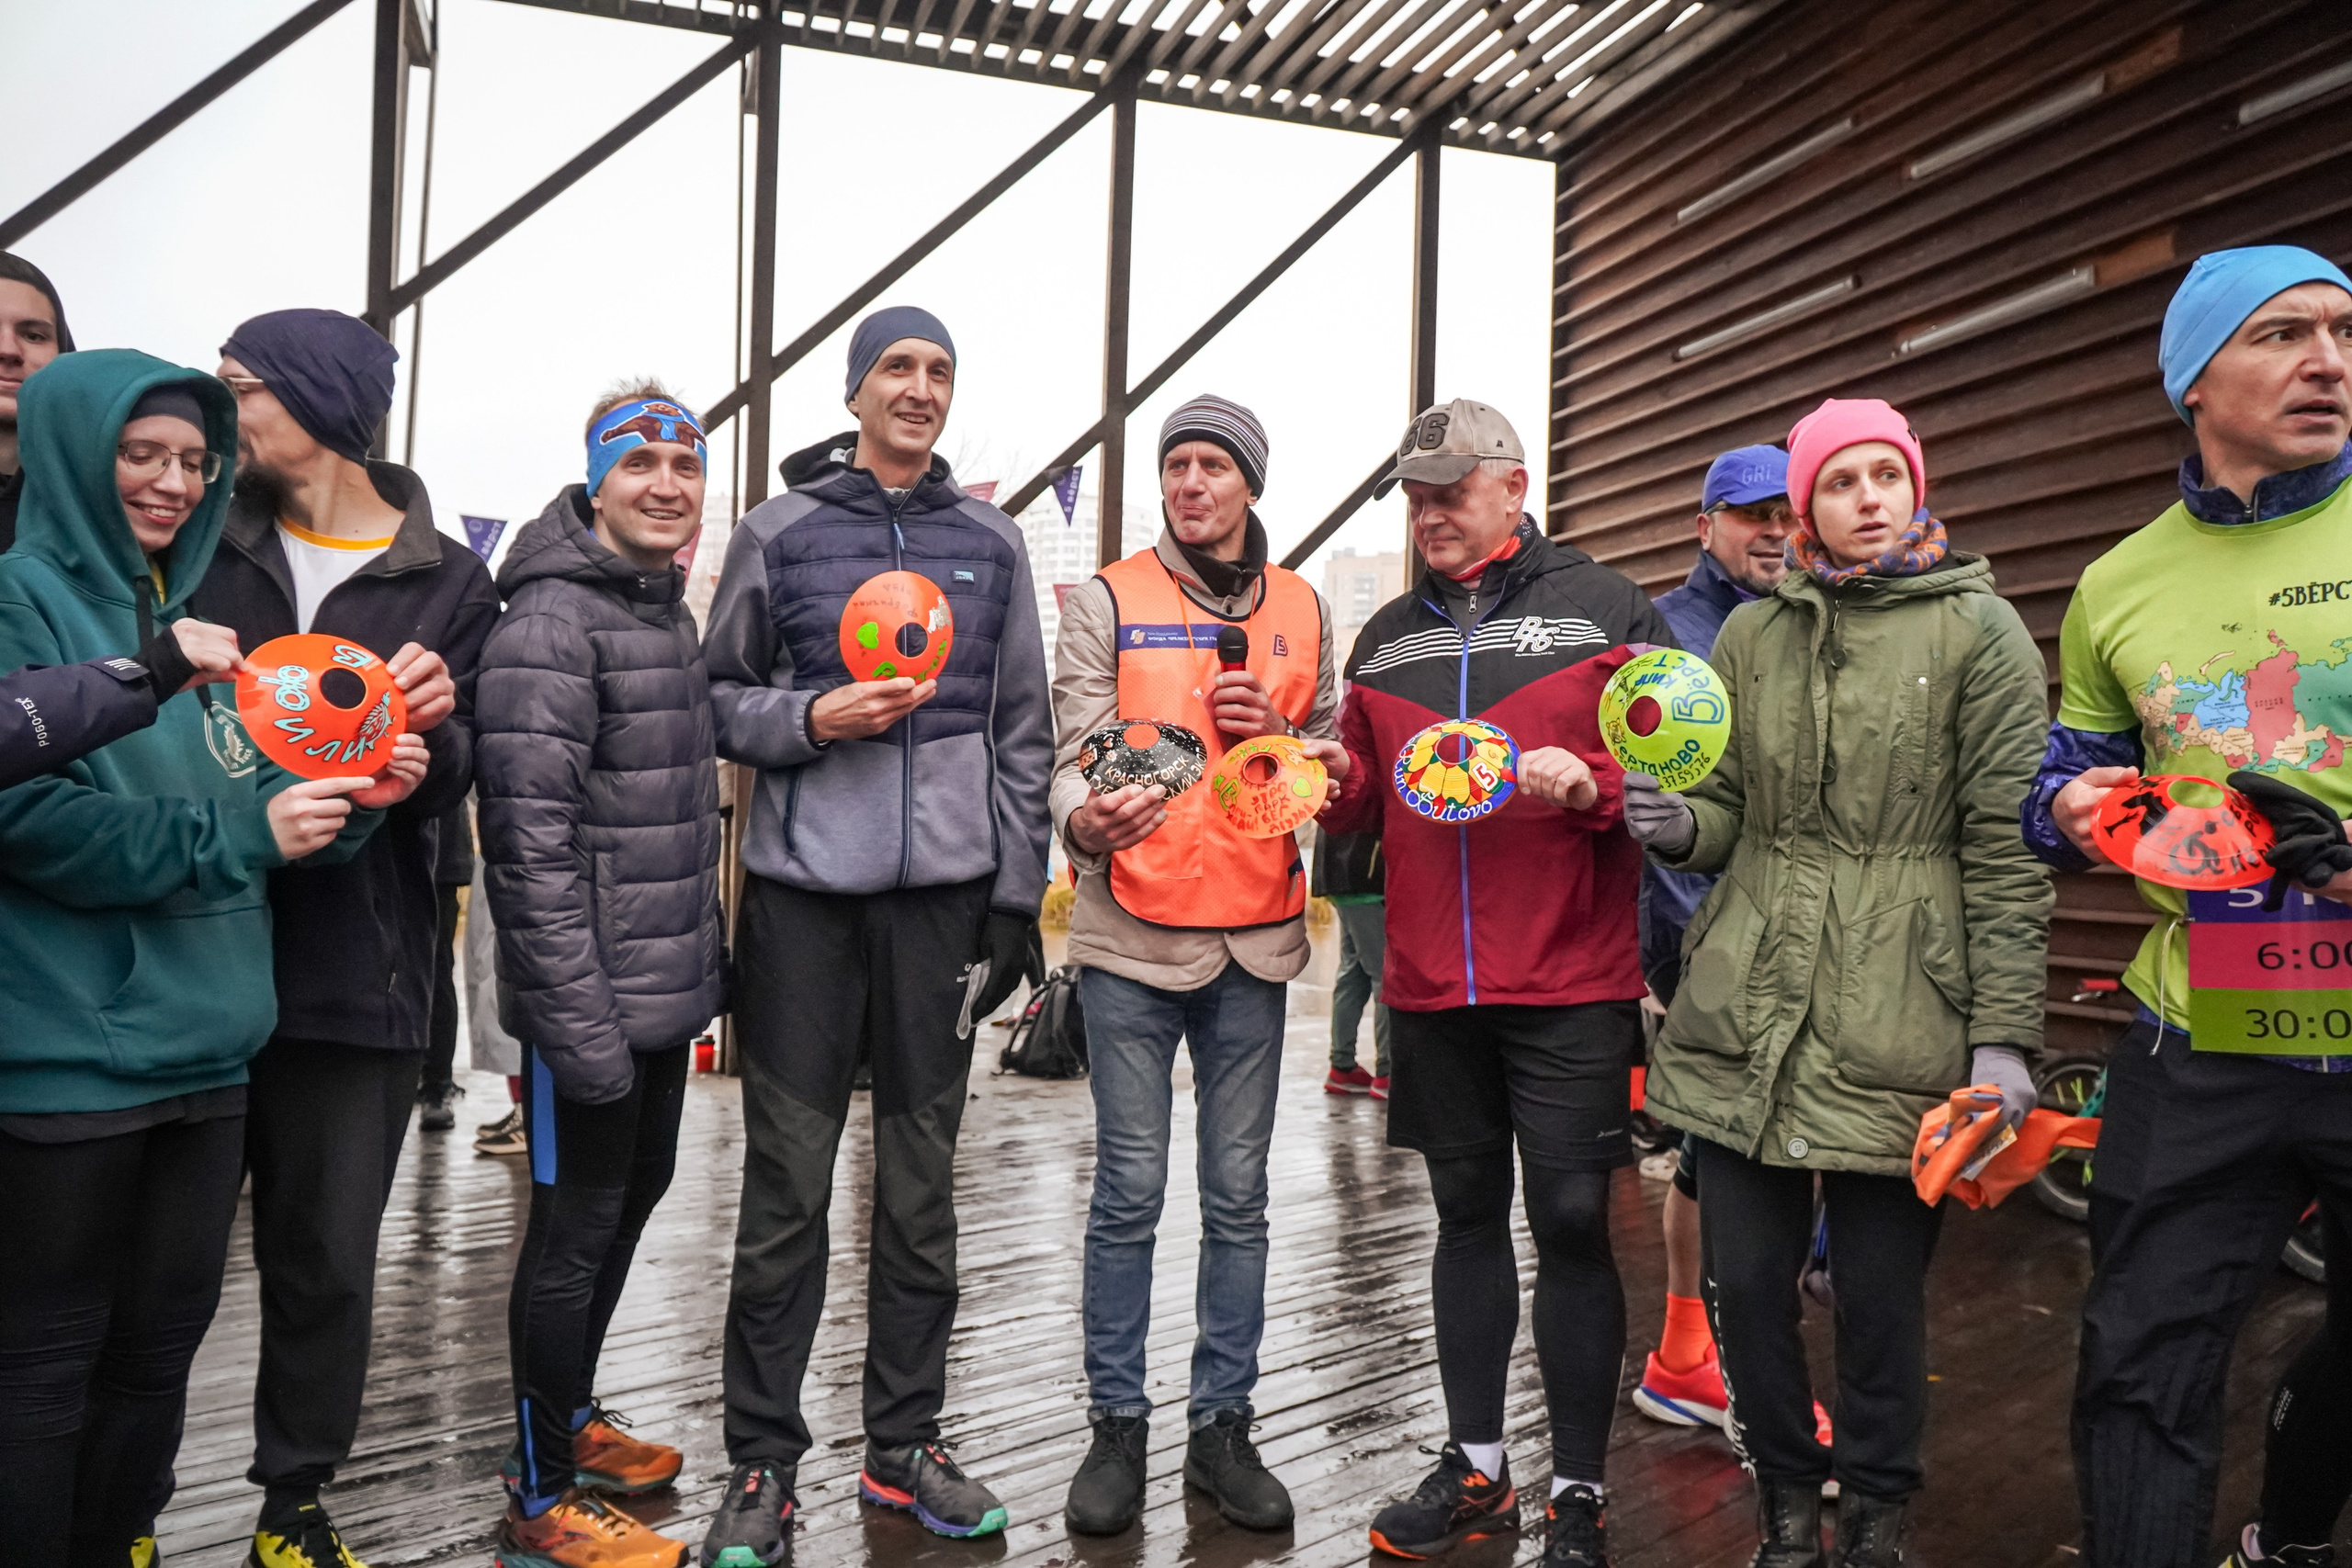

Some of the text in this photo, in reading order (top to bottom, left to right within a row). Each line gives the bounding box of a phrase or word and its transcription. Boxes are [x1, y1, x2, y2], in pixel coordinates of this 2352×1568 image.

[1400, 412, 1450, 457] 66
[2268, 579, 2352, 607] #5ВЁРС
[1104, 754, 1189, 786] КРАСНОГОРСК
[2256, 941, 2352, 970] 6:0
